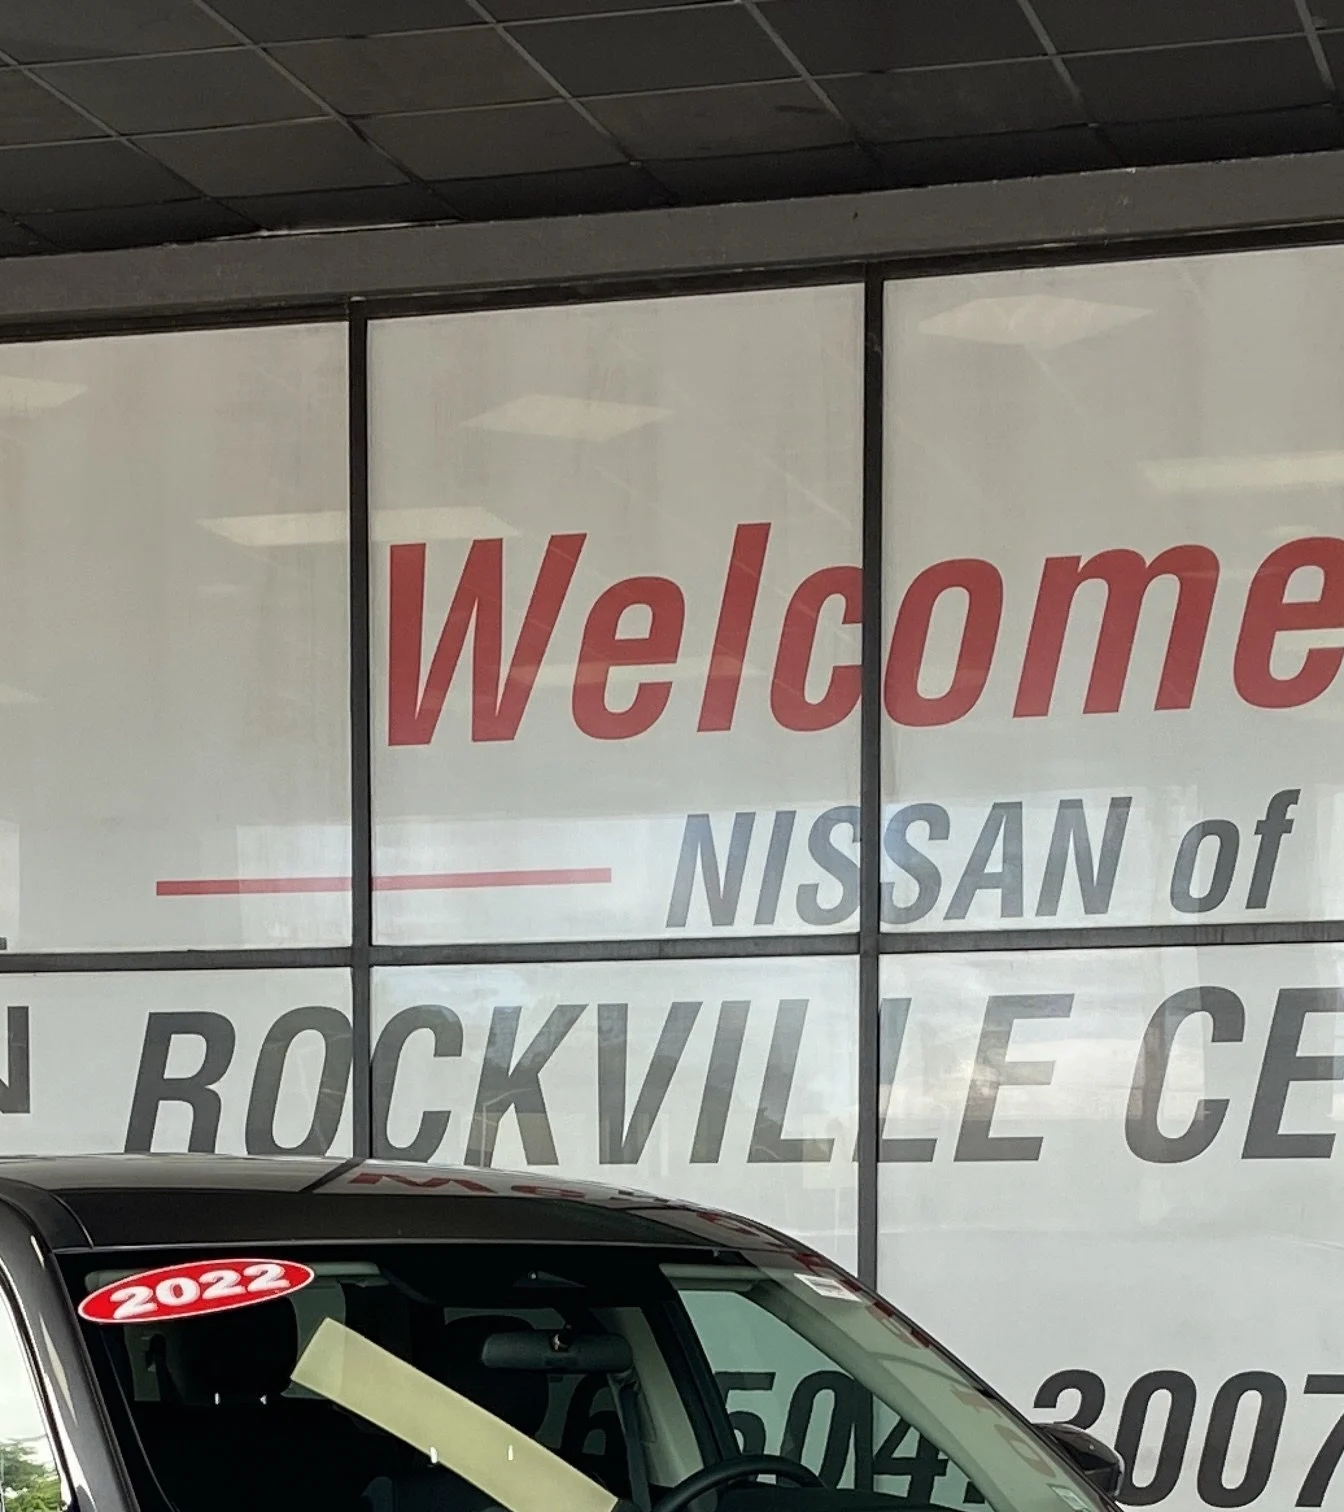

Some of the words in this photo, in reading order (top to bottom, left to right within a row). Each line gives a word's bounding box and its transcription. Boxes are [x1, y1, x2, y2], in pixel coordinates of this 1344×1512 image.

[665, 795, 1133, 928] NISSAN
[1169, 788, 1302, 914] of
[123, 992, 1075, 1166] ROCKVILLE
[110, 1263, 292, 1320] 2022
